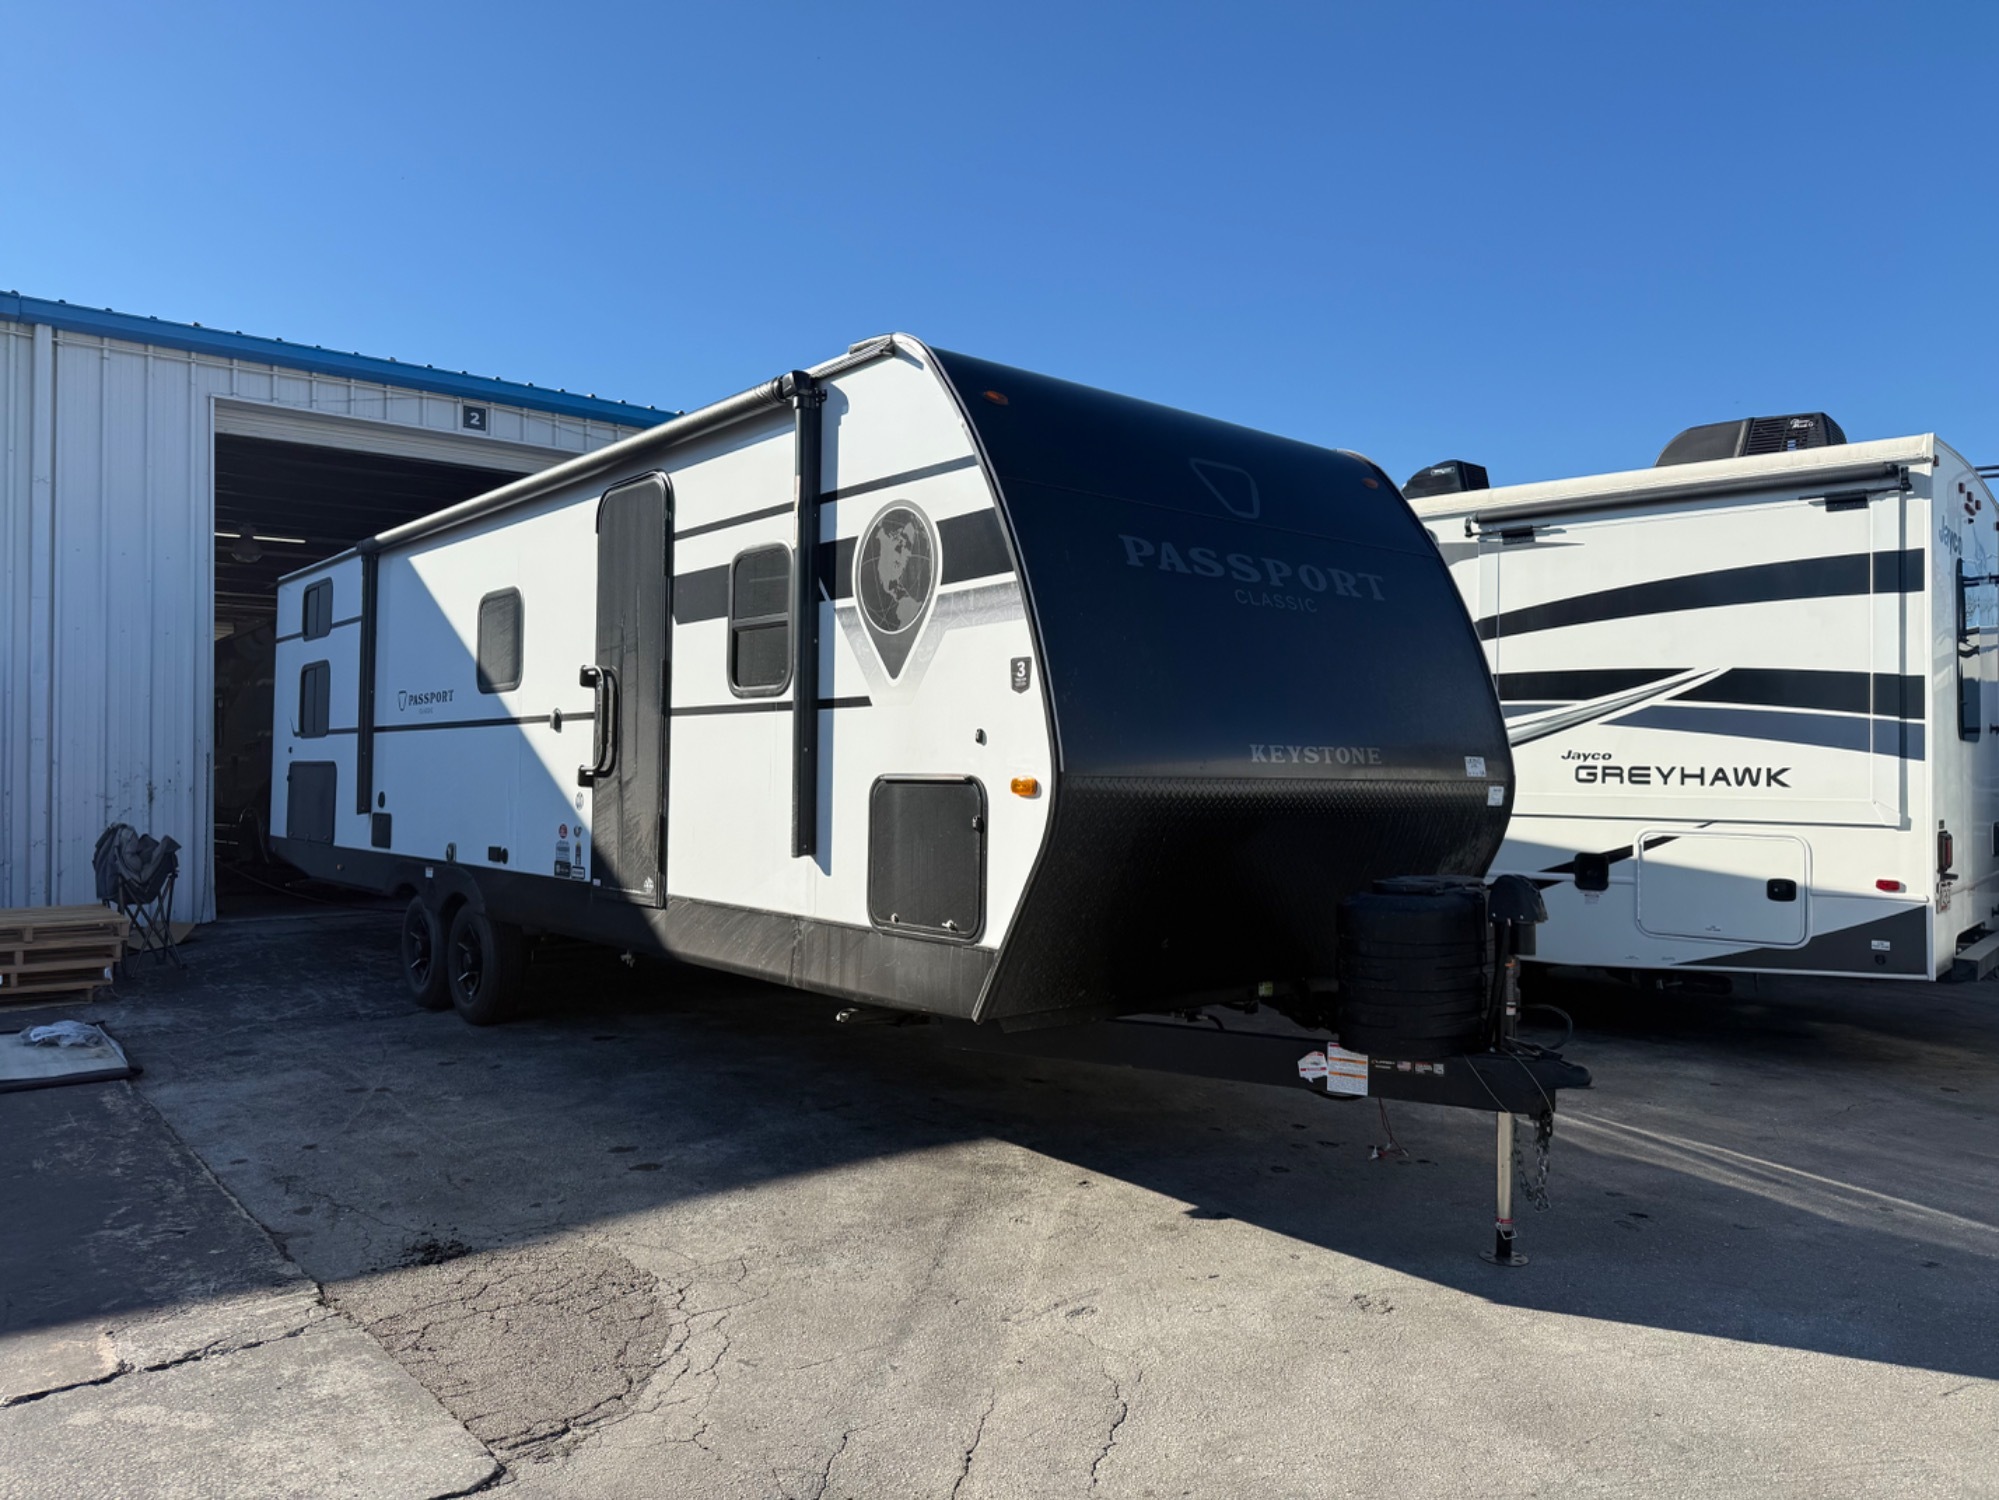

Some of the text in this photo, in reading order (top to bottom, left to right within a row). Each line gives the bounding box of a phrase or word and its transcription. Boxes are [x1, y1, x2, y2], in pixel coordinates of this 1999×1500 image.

[470, 412, 480, 425] 2
[1118, 534, 1385, 601] PASSPORT
[1235, 589, 1318, 613] CLASSIC
[1017, 661, 1026, 677] 3
[408, 689, 454, 706] PASSPORT
[1249, 744, 1382, 765] KEYSTONE
[1561, 750, 1612, 762] Jayco
[1575, 765, 1792, 788] GREYHAWK
